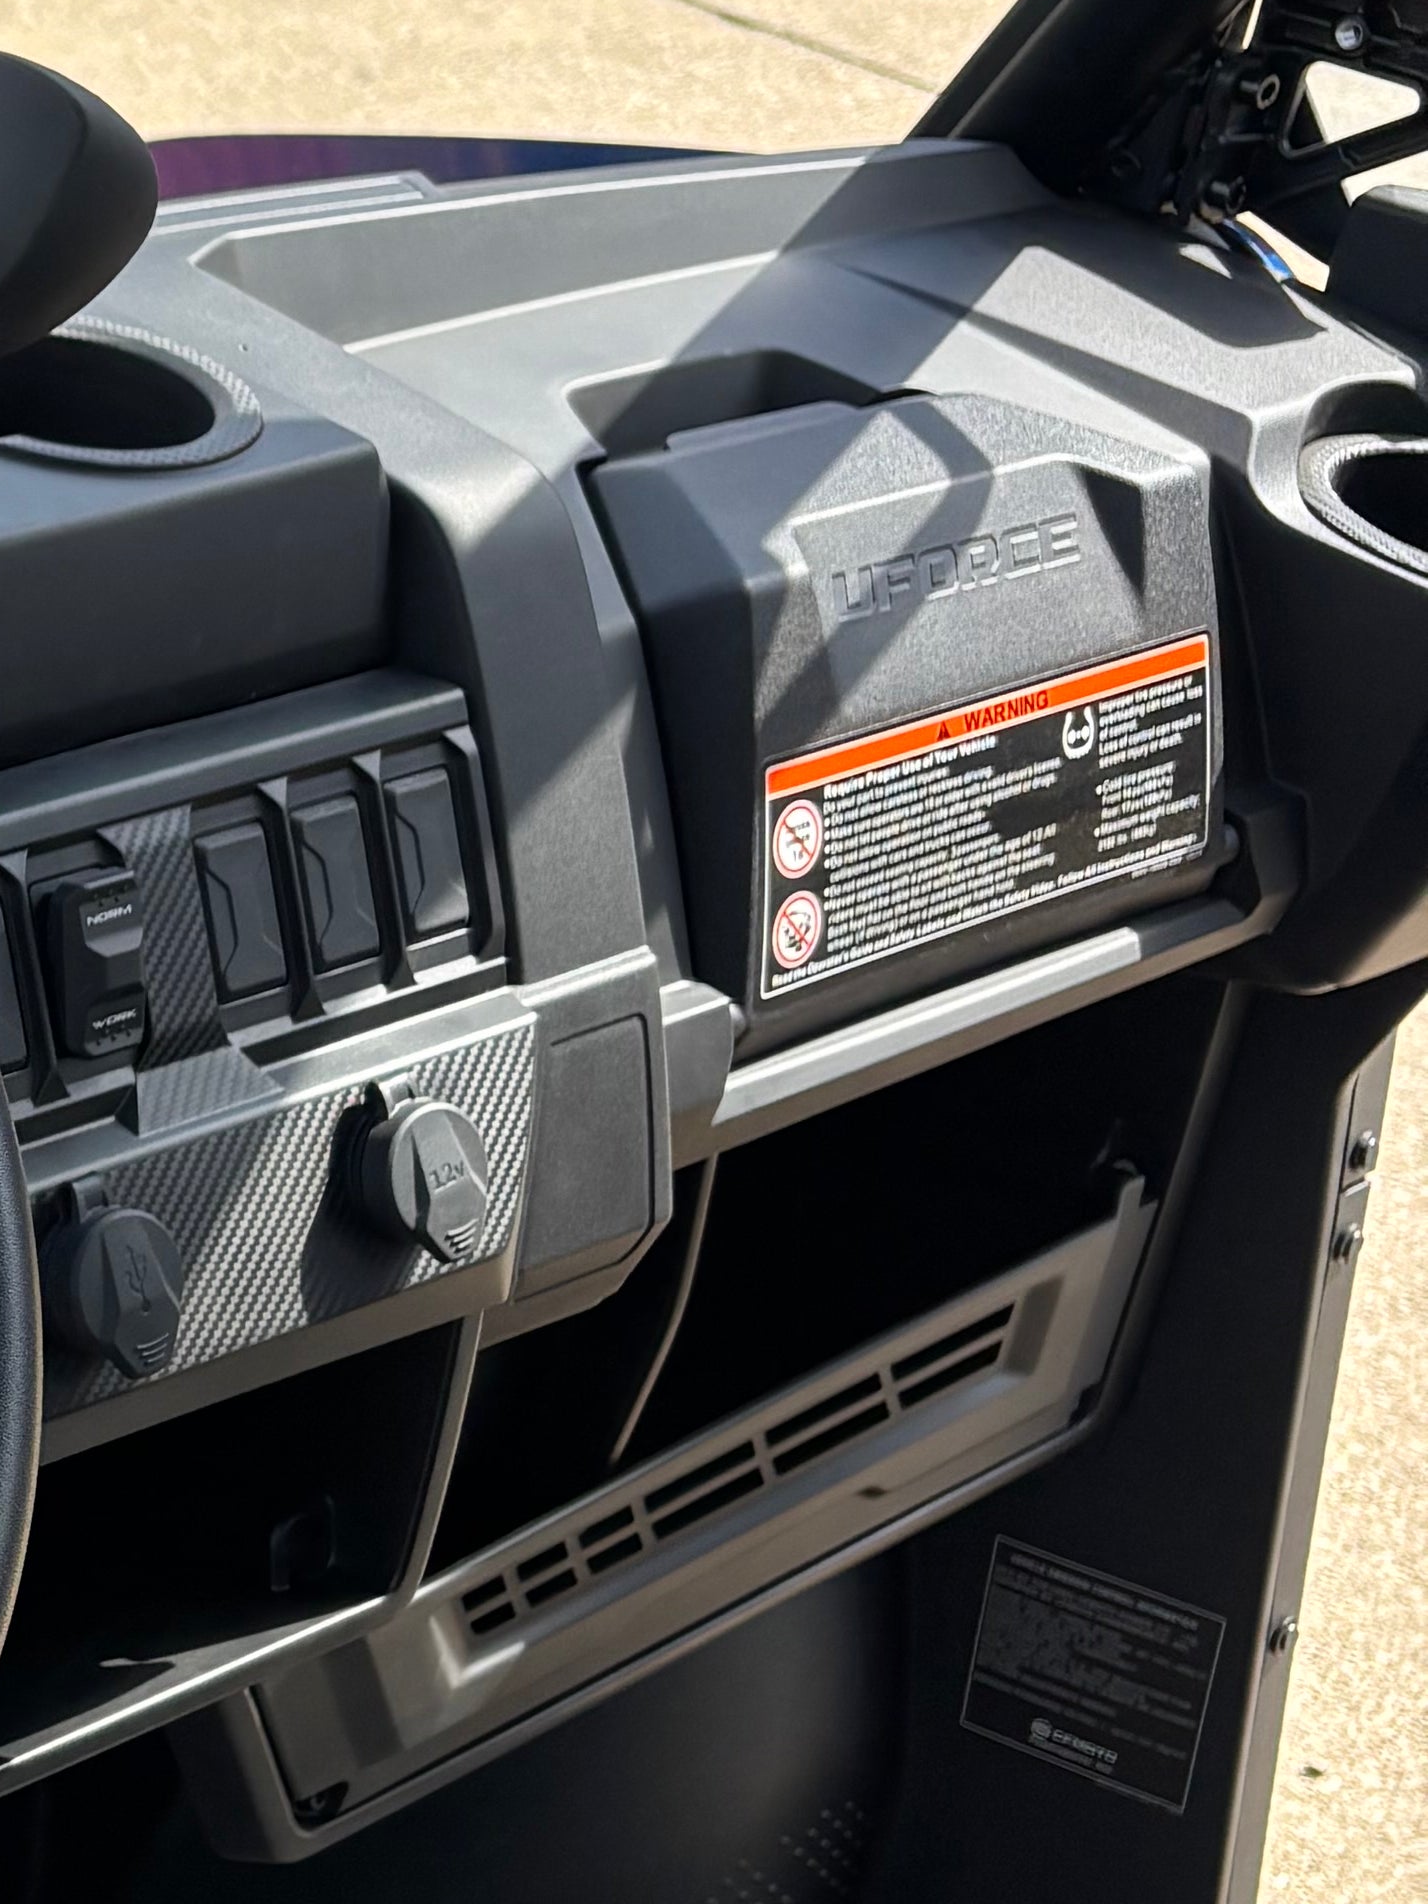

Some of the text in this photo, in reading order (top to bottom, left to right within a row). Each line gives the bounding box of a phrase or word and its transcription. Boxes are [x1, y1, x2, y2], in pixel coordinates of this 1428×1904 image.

[832, 513, 1081, 622] UFORCE
[963, 690, 1050, 733] WARNING
[86, 903, 133, 928] NORM
[91, 1007, 138, 1031] WORK
